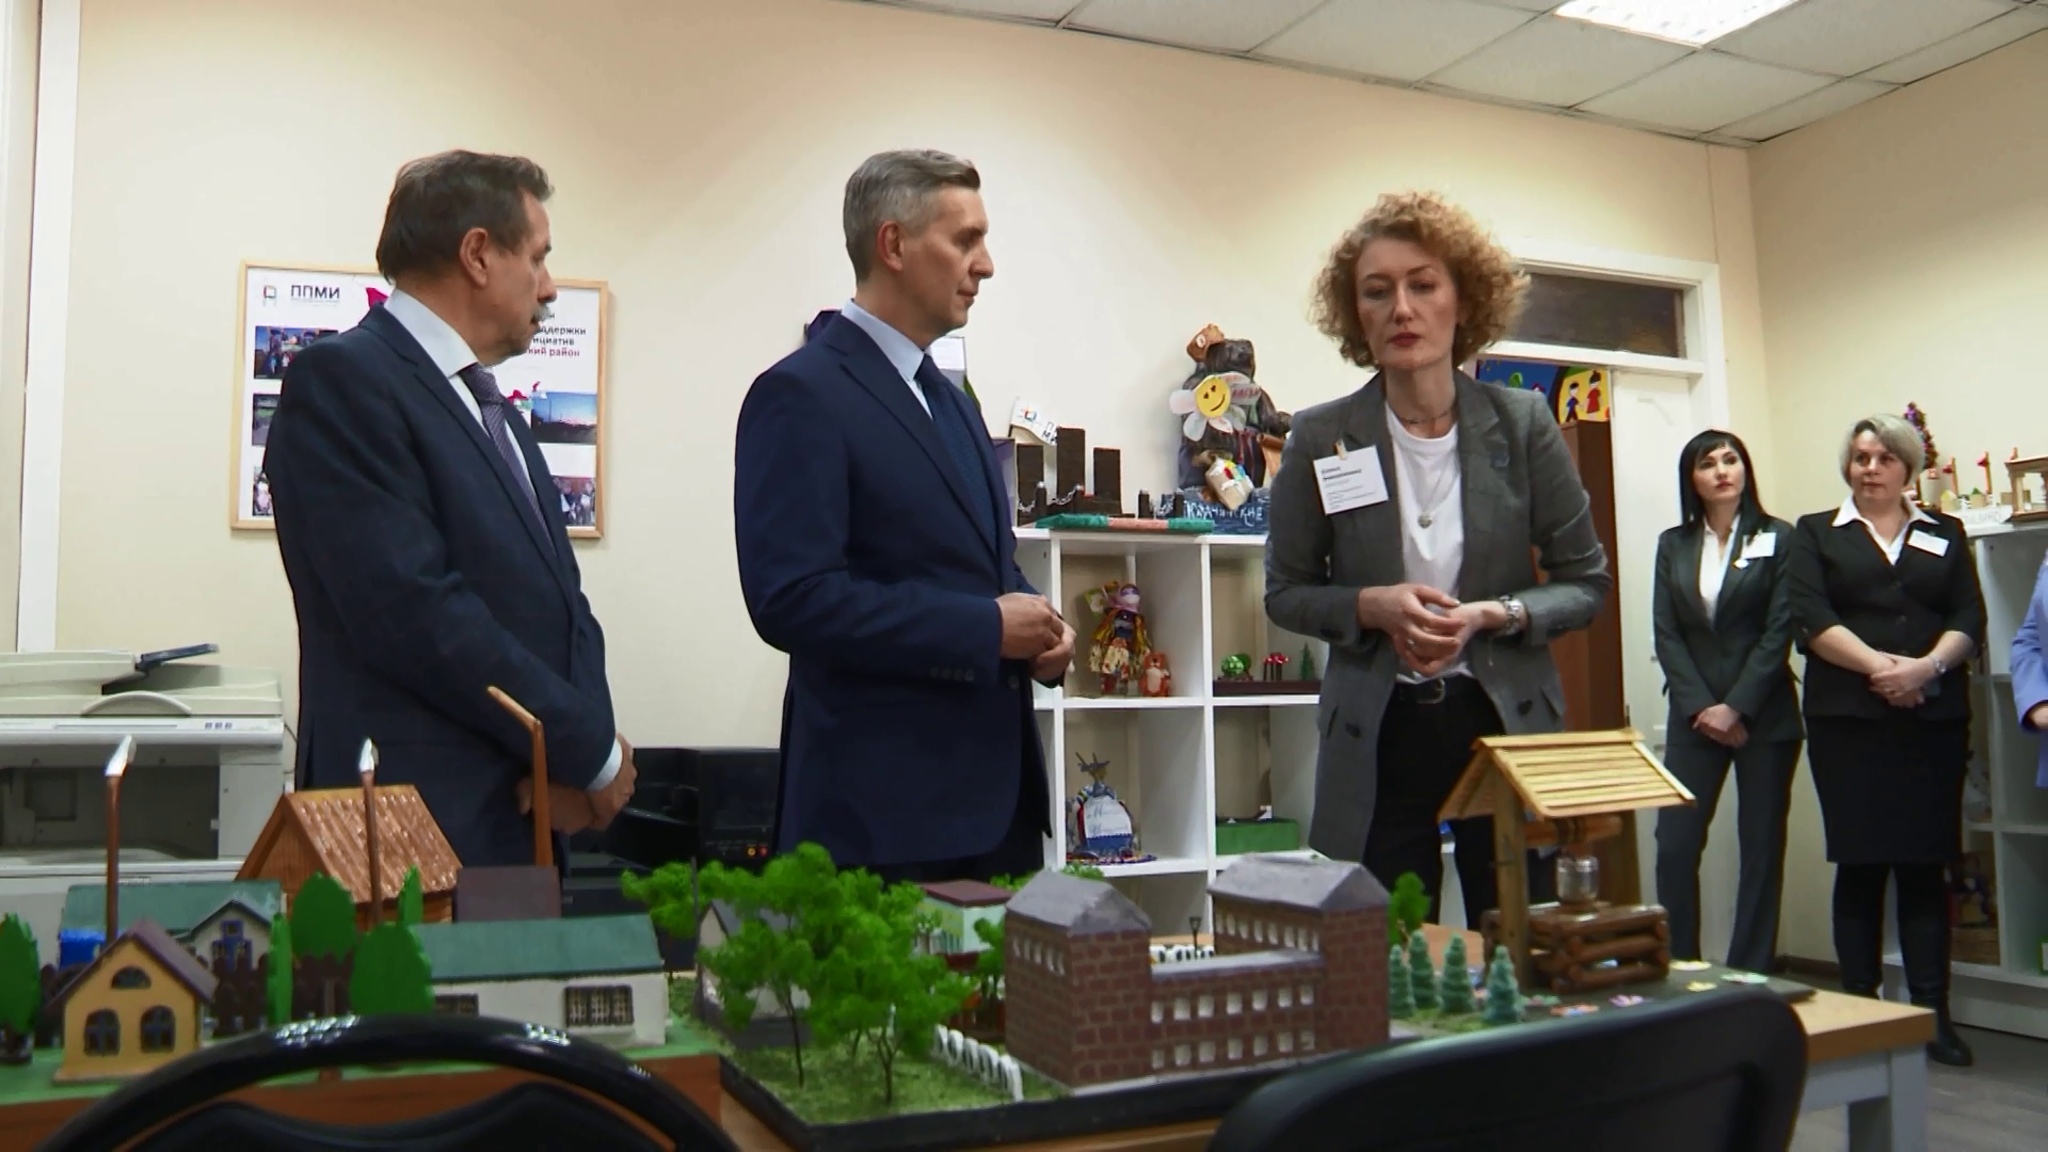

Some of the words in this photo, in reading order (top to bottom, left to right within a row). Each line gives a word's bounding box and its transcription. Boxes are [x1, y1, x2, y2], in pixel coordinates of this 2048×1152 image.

[291, 285, 340, 298] ППМИ
[539, 327, 586, 335] ддержки
[533, 338, 574, 346] ициатив
[529, 347, 546, 355] кий
[549, 348, 580, 357] район
